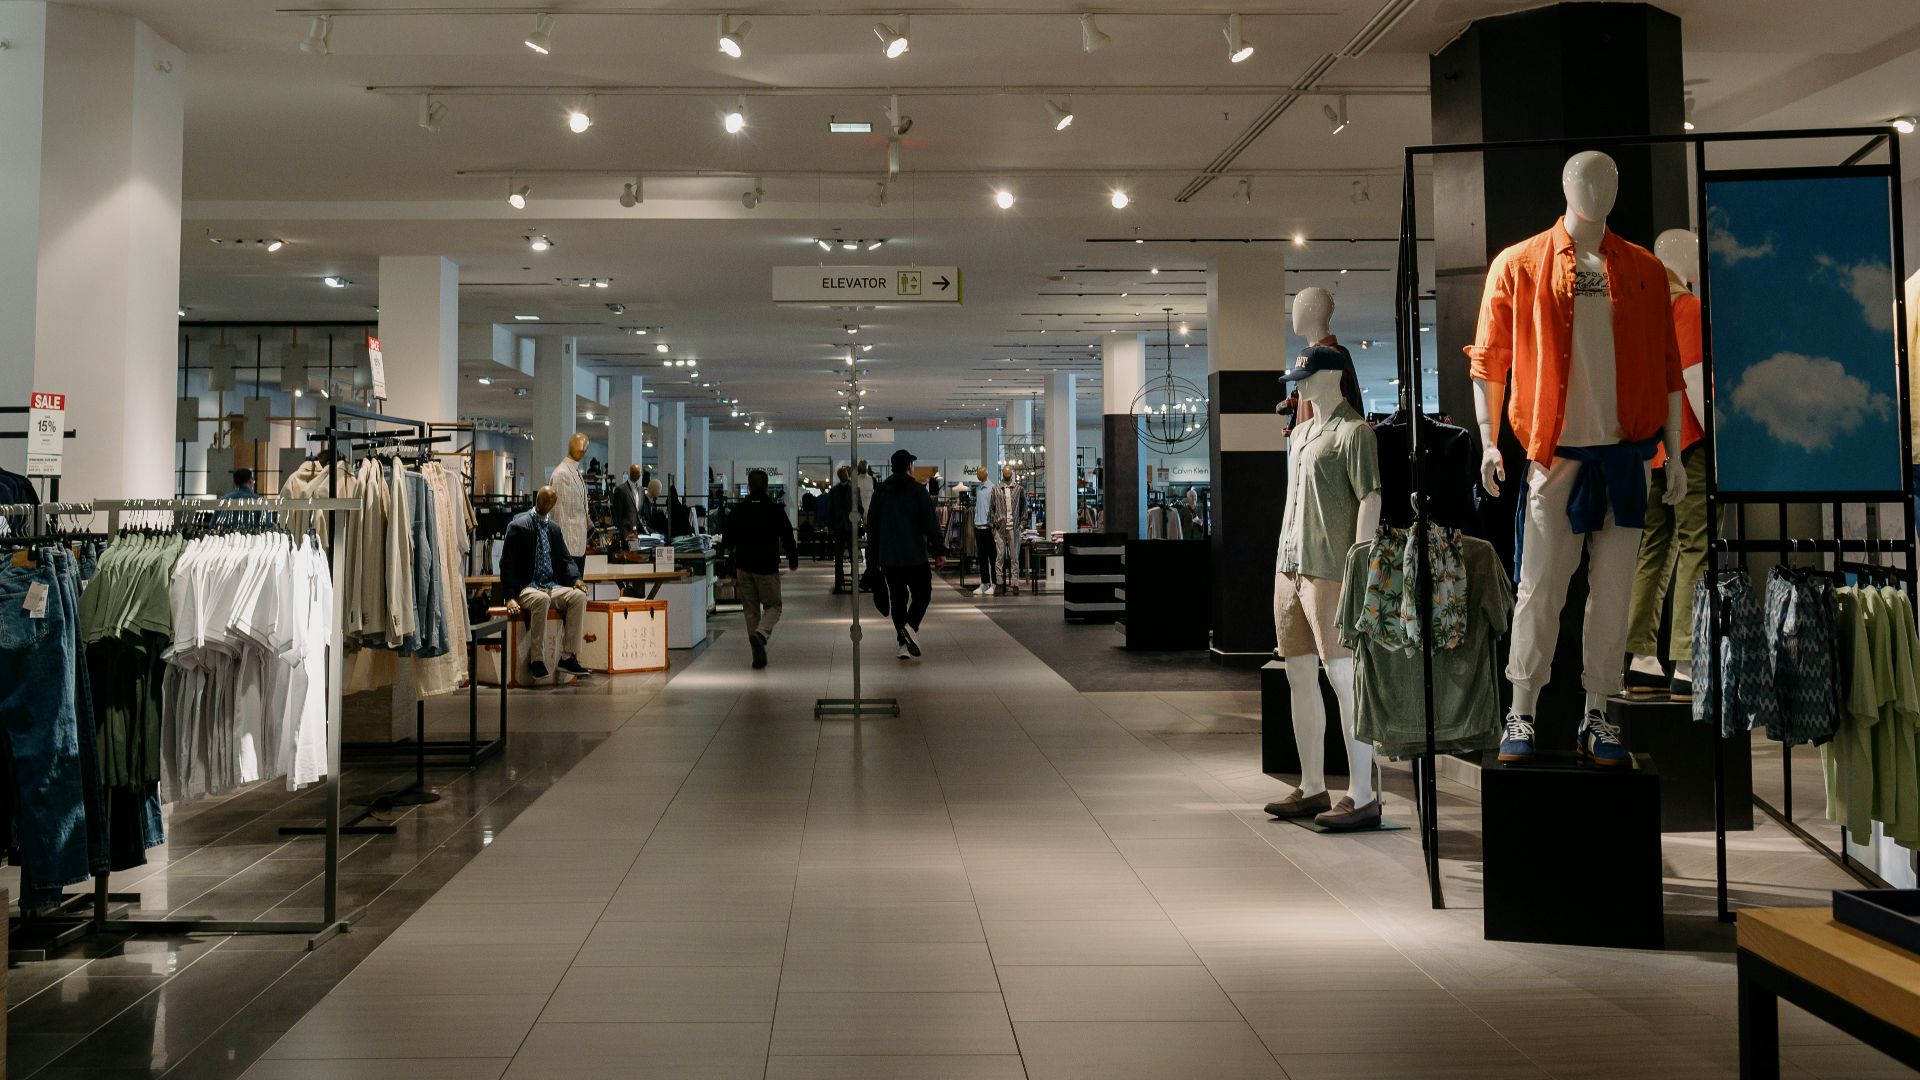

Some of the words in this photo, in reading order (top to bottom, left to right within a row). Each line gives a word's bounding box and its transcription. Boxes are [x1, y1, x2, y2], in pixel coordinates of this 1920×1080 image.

[822, 278, 887, 289] ELEVATOR
[35, 394, 61, 410] SALE
[38, 420, 57, 433] 15%
[1173, 467, 1193, 475] Calvin
[1194, 467, 1209, 475] Klein
